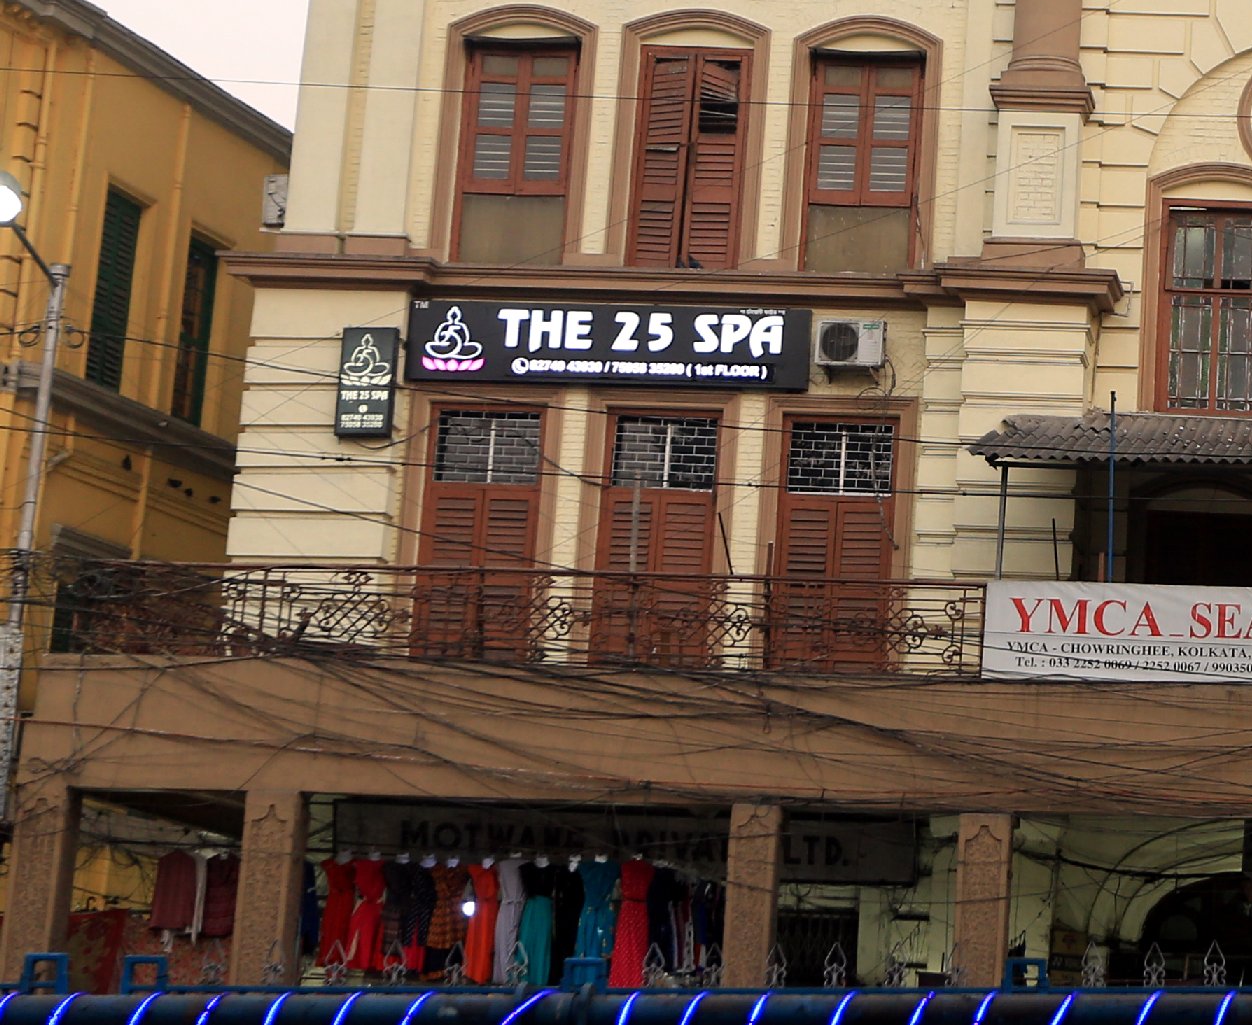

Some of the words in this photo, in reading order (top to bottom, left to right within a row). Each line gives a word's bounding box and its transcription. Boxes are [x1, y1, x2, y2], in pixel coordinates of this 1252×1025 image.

[414, 300, 430, 309] TM
[497, 308, 594, 353] THE
[611, 311, 674, 352] 25
[692, 314, 785, 358] SPA
[340, 390, 358, 401] THE
[359, 390, 370, 400] 25
[370, 390, 389, 401] SPA
[1006, 641, 1048, 653] YMCA
[1061, 642, 1174, 657] CHOWRINGHEE,
[1178, 645, 1251, 660] KOLKATA,
[1015, 656, 1037, 668] Tel.
[1049, 657, 1070, 668] 033
[1073, 658, 1101, 669] 2252
[1103, 659, 1132, 670] 0069
[1142, 660, 1170, 671] 2252
[1173, 661, 1201, 672] 0067
[783, 832, 850, 867] LTD.
